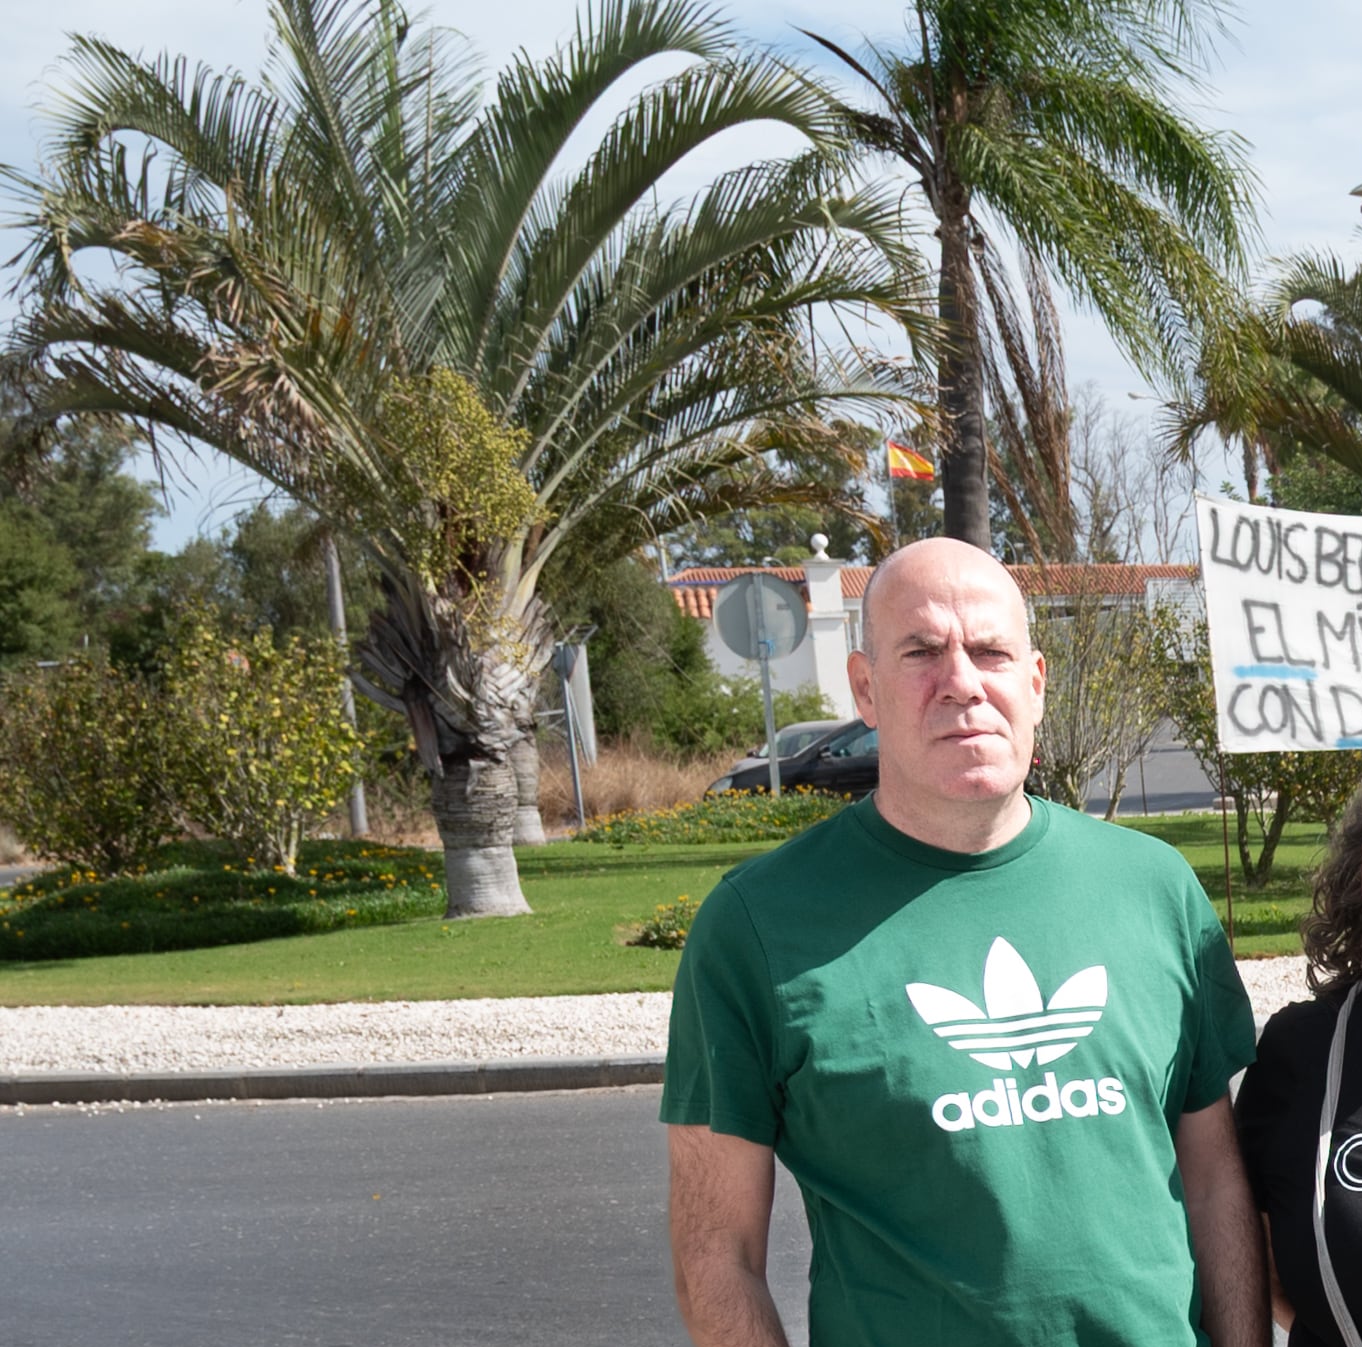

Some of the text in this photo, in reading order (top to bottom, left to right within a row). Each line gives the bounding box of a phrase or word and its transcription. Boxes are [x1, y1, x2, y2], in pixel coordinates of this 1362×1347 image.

[1210, 508, 1308, 584] LOUIS
[1242, 600, 1316, 667] EL
[1228, 678, 1324, 741] CON
[932, 1072, 1127, 1132] adidas
